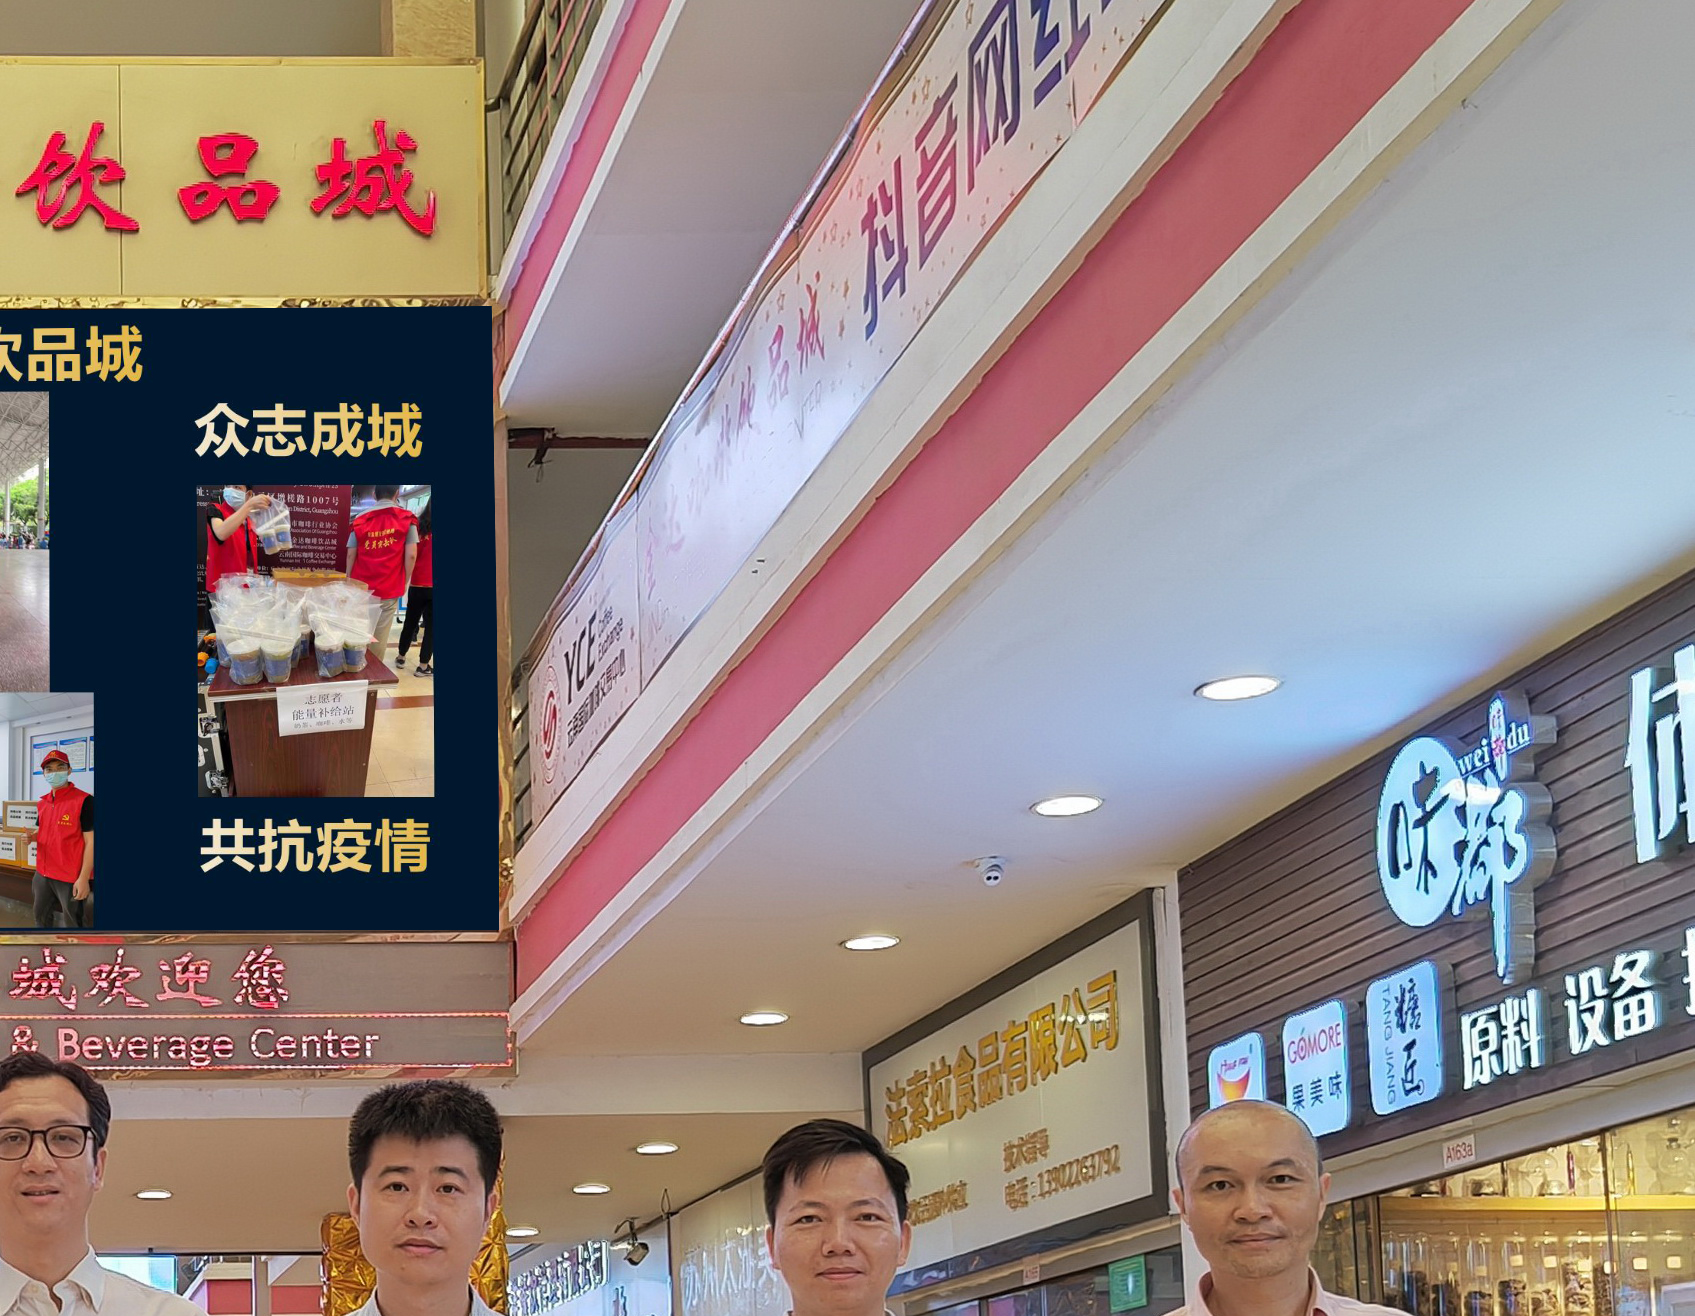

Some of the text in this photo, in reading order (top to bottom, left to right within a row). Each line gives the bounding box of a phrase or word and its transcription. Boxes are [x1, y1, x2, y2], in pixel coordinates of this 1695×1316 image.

[194, 402, 424, 459] 众志成城
[563, 610, 597, 705] YCE
[200, 818, 431, 873] 共抗疫情
[57, 1028, 235, 1067] Beverage
[251, 1028, 380, 1060] Center
[1460, 988, 1544, 1091] 原料
[1563, 948, 1660, 1056] 设备
[884, 969, 1120, 1149] 法索拉食品有限公司
[1292, 1070, 1342, 1112] 果美味
[1445, 1140, 1474, 1163] A163a
